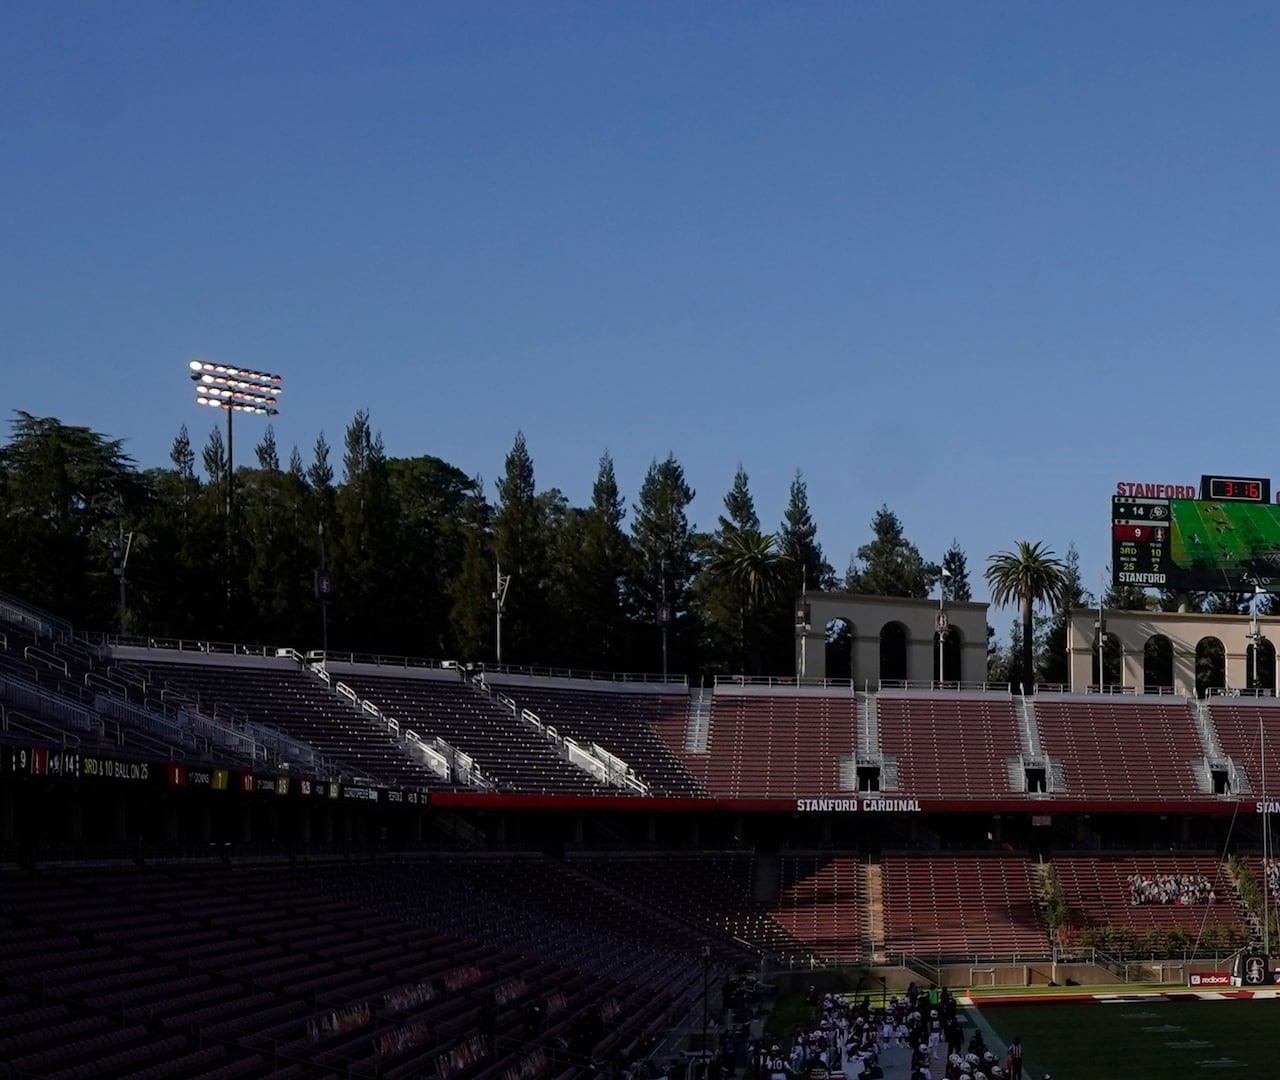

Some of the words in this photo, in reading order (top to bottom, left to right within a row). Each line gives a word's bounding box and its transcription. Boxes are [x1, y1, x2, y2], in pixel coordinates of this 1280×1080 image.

[1117, 482, 1196, 499] STANFORD
[1225, 481, 1258, 497] 3:16
[1132, 506, 1144, 516] 14
[1135, 528, 1141, 537] 9
[1120, 547, 1137, 555] 3RD
[1151, 549, 1161, 557] 10
[1123, 563, 1135, 571] 25
[1153, 564, 1159, 572] 2
[1119, 572, 1166, 584] STANFORD
[20, 750, 26, 768] 9
[65, 754, 74, 773] 14
[84, 758, 98, 775] 3RD
[105, 760, 113, 776] 10
[115, 762, 130, 778] BALL
[131, 764, 139, 779] ON
[141, 763, 148, 779] 25
[797, 799, 858, 812] STANFORD
[863, 799, 922, 812] CARDINAL
